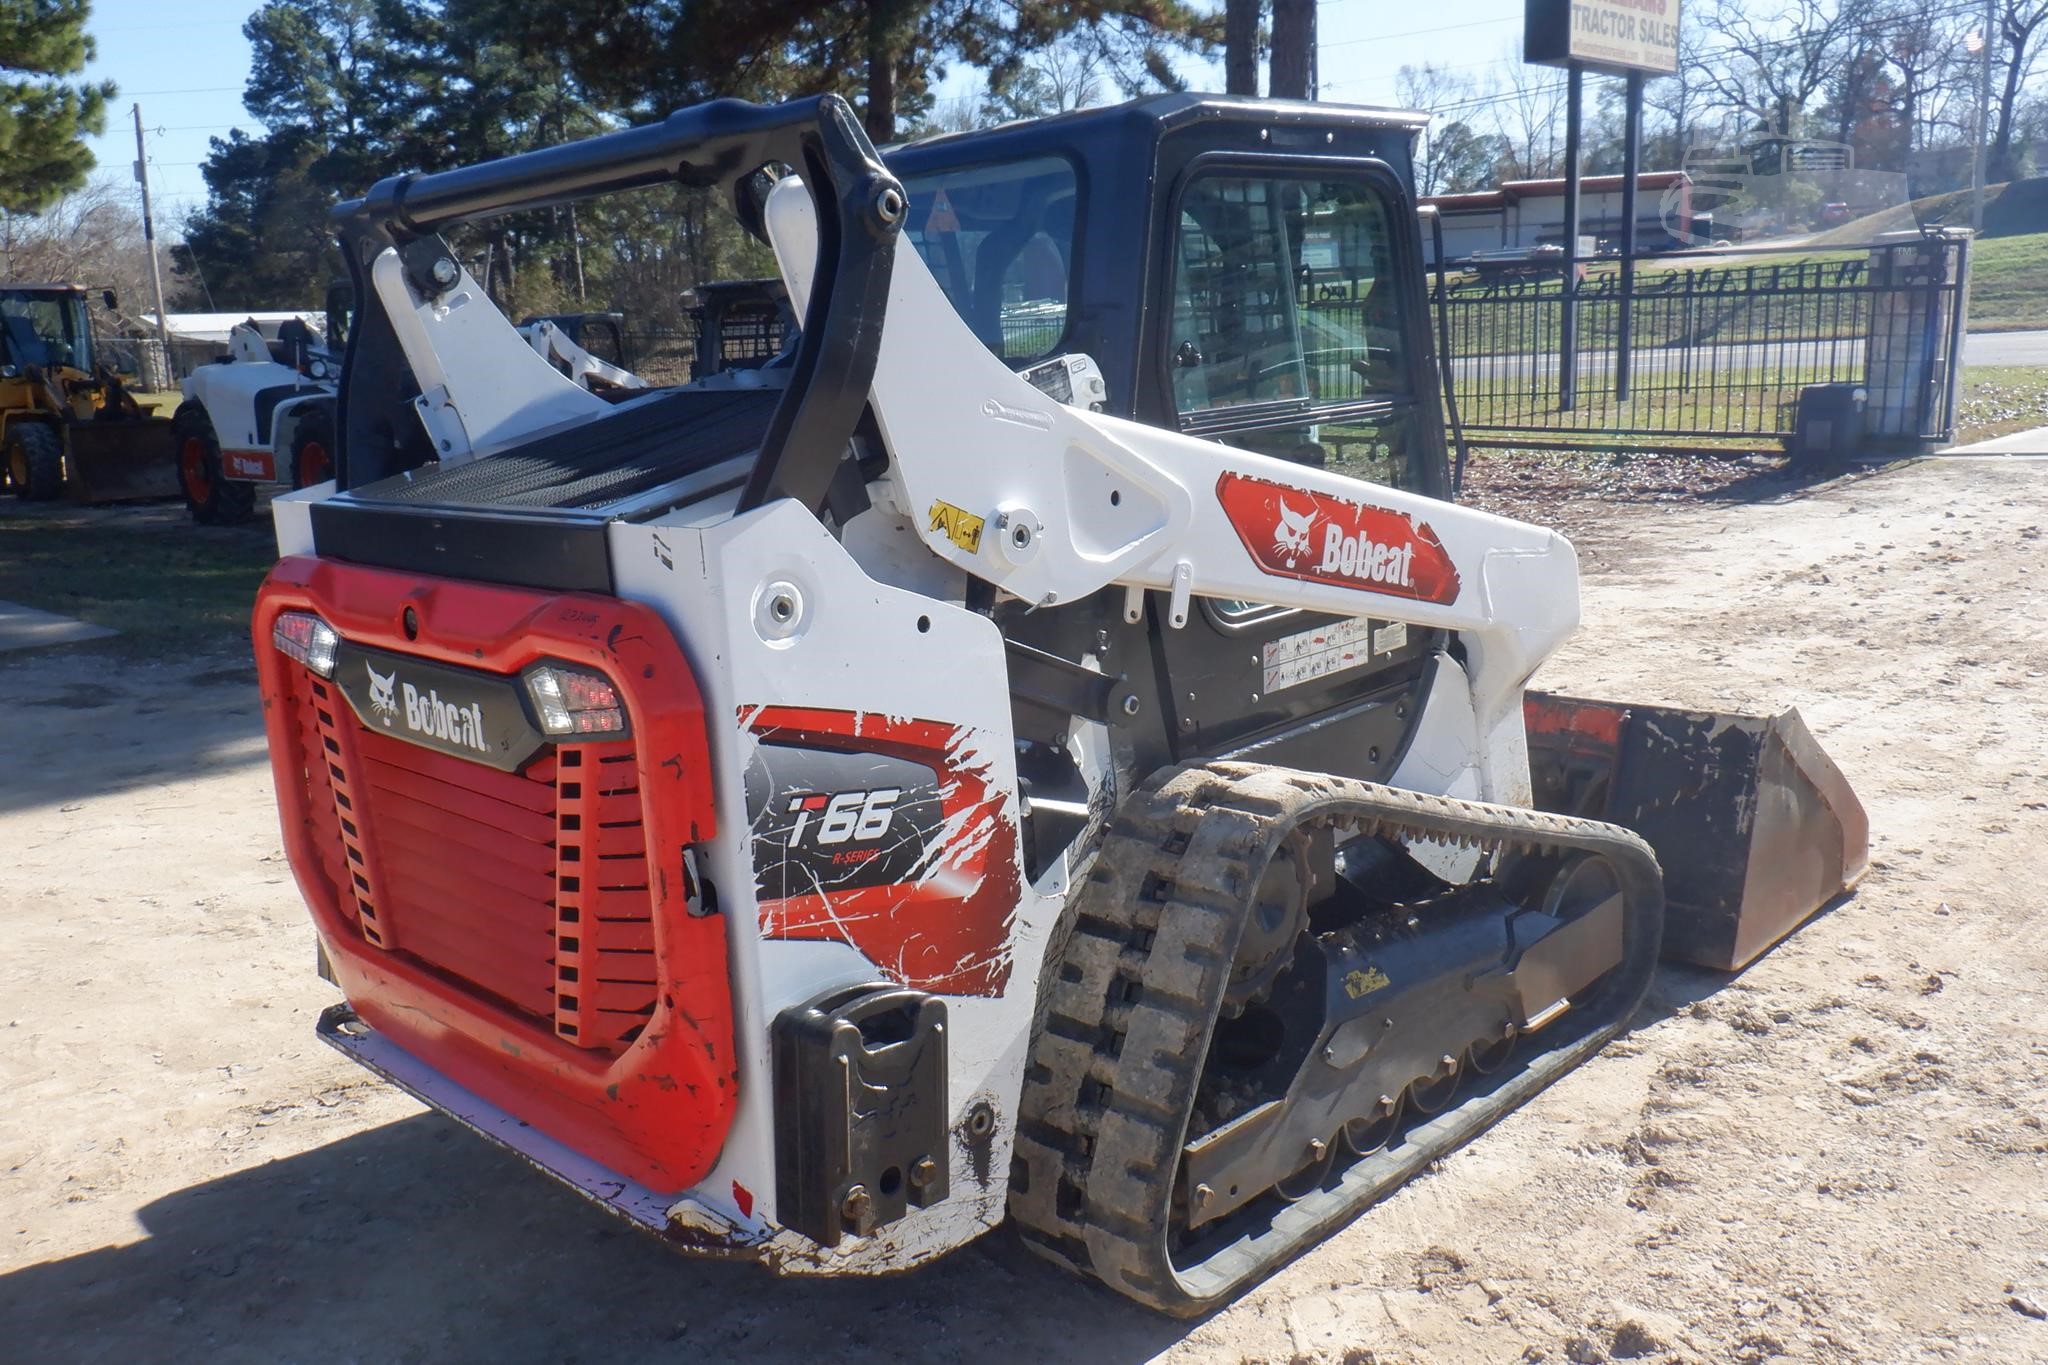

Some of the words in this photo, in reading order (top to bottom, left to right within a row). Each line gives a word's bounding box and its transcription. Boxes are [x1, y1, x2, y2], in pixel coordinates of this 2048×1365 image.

[1572, 4, 1636, 41] TRACTOR
[1639, 18, 1678, 49] SALES
[1322, 523, 1414, 587] Bobcat
[402, 682, 486, 752] Bobcat
[788, 789, 900, 848] T66
[832, 848, 881, 865] R-SERIES
